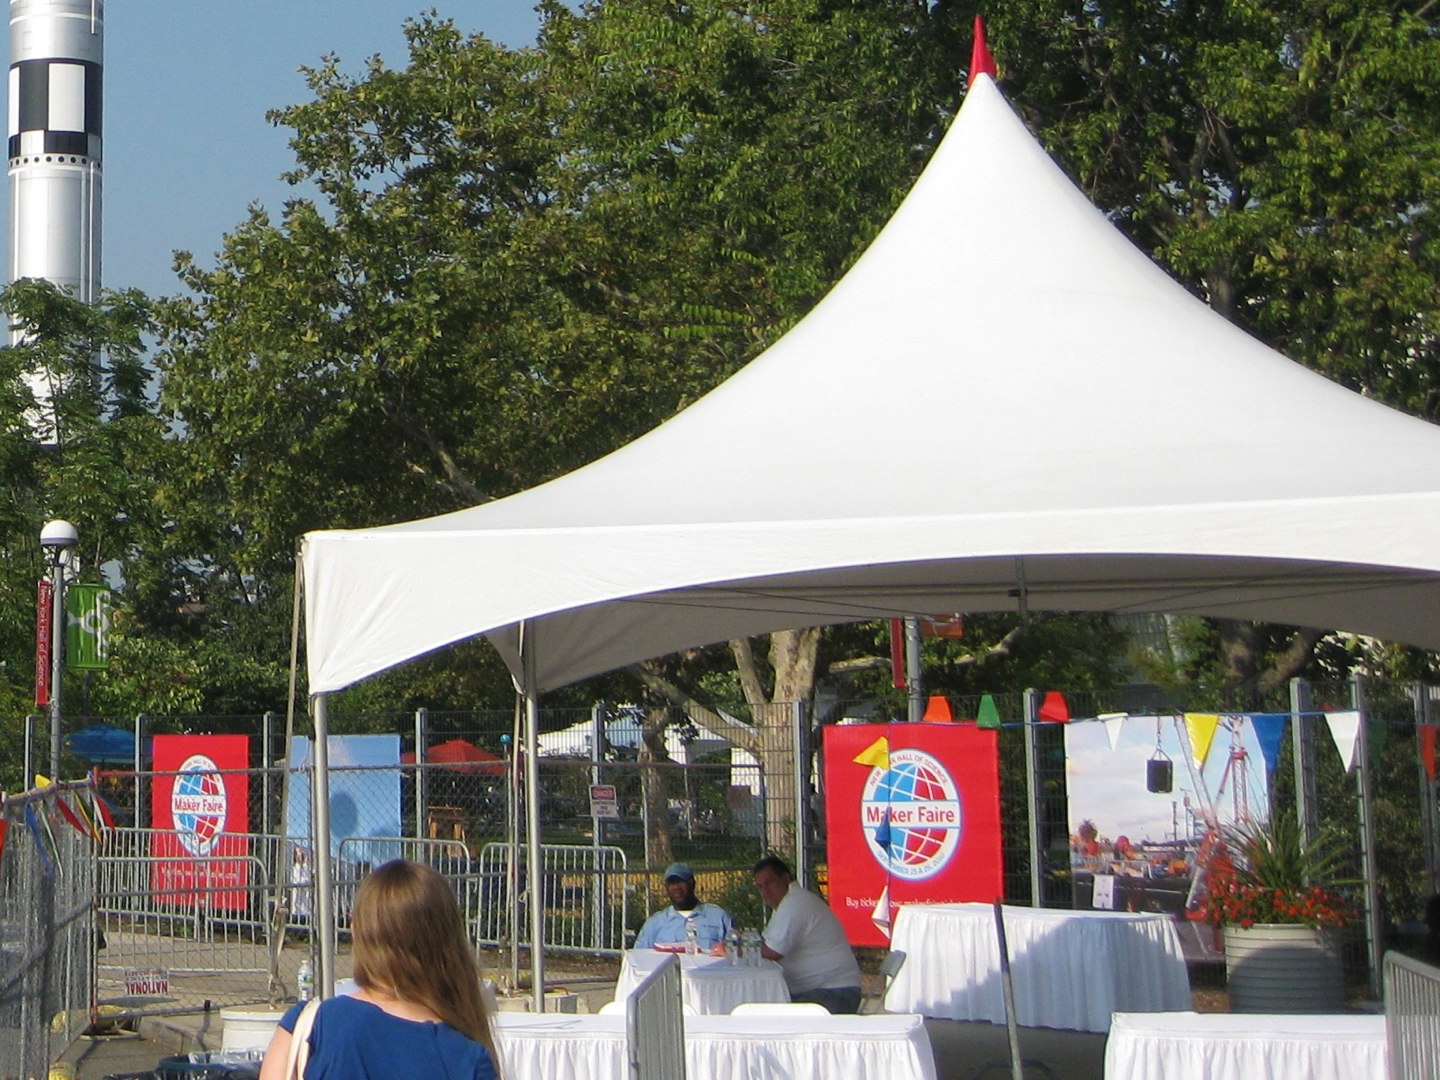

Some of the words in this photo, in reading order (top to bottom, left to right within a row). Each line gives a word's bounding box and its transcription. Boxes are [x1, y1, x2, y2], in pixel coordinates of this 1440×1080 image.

[38, 655, 48, 687] Science
[174, 799, 201, 812] Maker
[202, 800, 223, 813] Faire
[918, 806, 954, 823] Faire
[845, 897, 859, 909] Buy
[860, 897, 878, 907] ticke
[126, 981, 168, 995] NATIONAL
